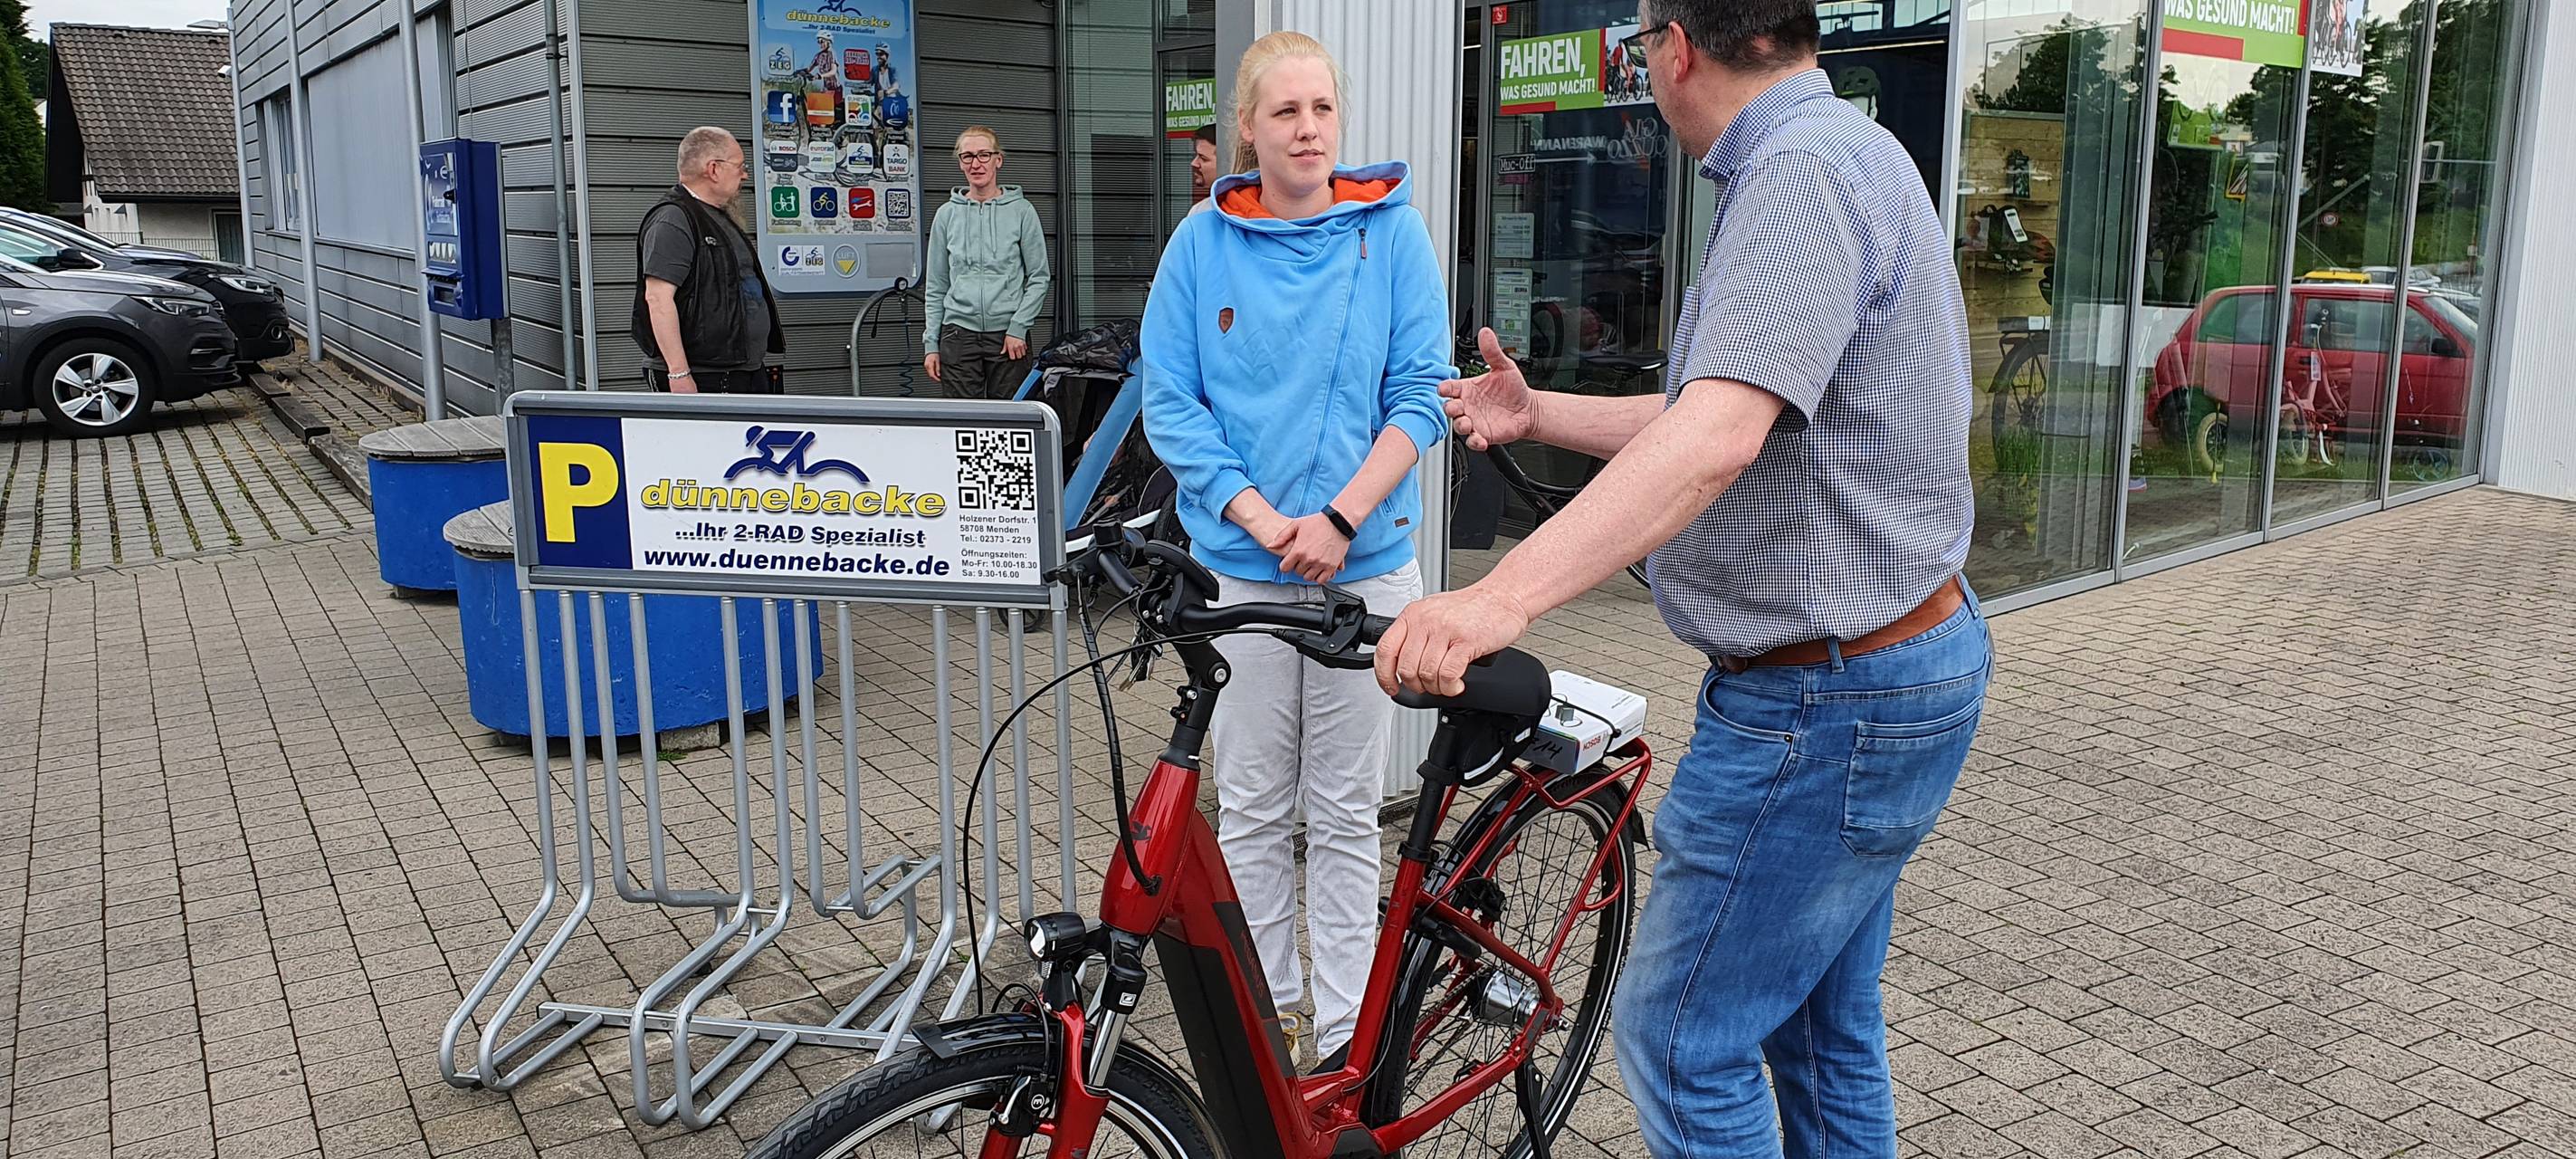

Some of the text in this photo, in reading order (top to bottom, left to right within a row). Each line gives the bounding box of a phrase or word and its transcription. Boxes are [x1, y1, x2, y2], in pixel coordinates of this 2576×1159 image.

[787, 9, 891, 28] dünnebacke
[2164, 0, 2295, 35] WAS GESUND MACHT!
[769, 59, 792, 70] ZEG
[1501, 37, 1586, 80] FAHREN,
[1166, 82, 1216, 113] FAHREN,
[1500, 78, 1595, 101] WAS GESUND MACHT!
[1500, 156, 1535, 170] Muc-Off
[539, 442, 619, 542] P
[641, 479, 946, 516] dünnebacke
[959, 514, 1036, 524] Holzener Dorfstr. 1
[959, 524, 1019, 533] 58708 Menden
[675, 522, 926, 545] ...Ihr 2-RAD Spezialist
[960, 534, 978, 542] Tel.:
[979, 535, 1005, 543] 02373
[1012, 536, 1032, 544] 2219
[644, 548, 949, 576] www.duennebacke.de
[960, 548, 1027, 560] Öffnungszeiten:
[961, 560, 1037, 570] Mo-Fr: 10.00-18.30
[962, 569, 1020, 579] Sa: 9.30-16.00
